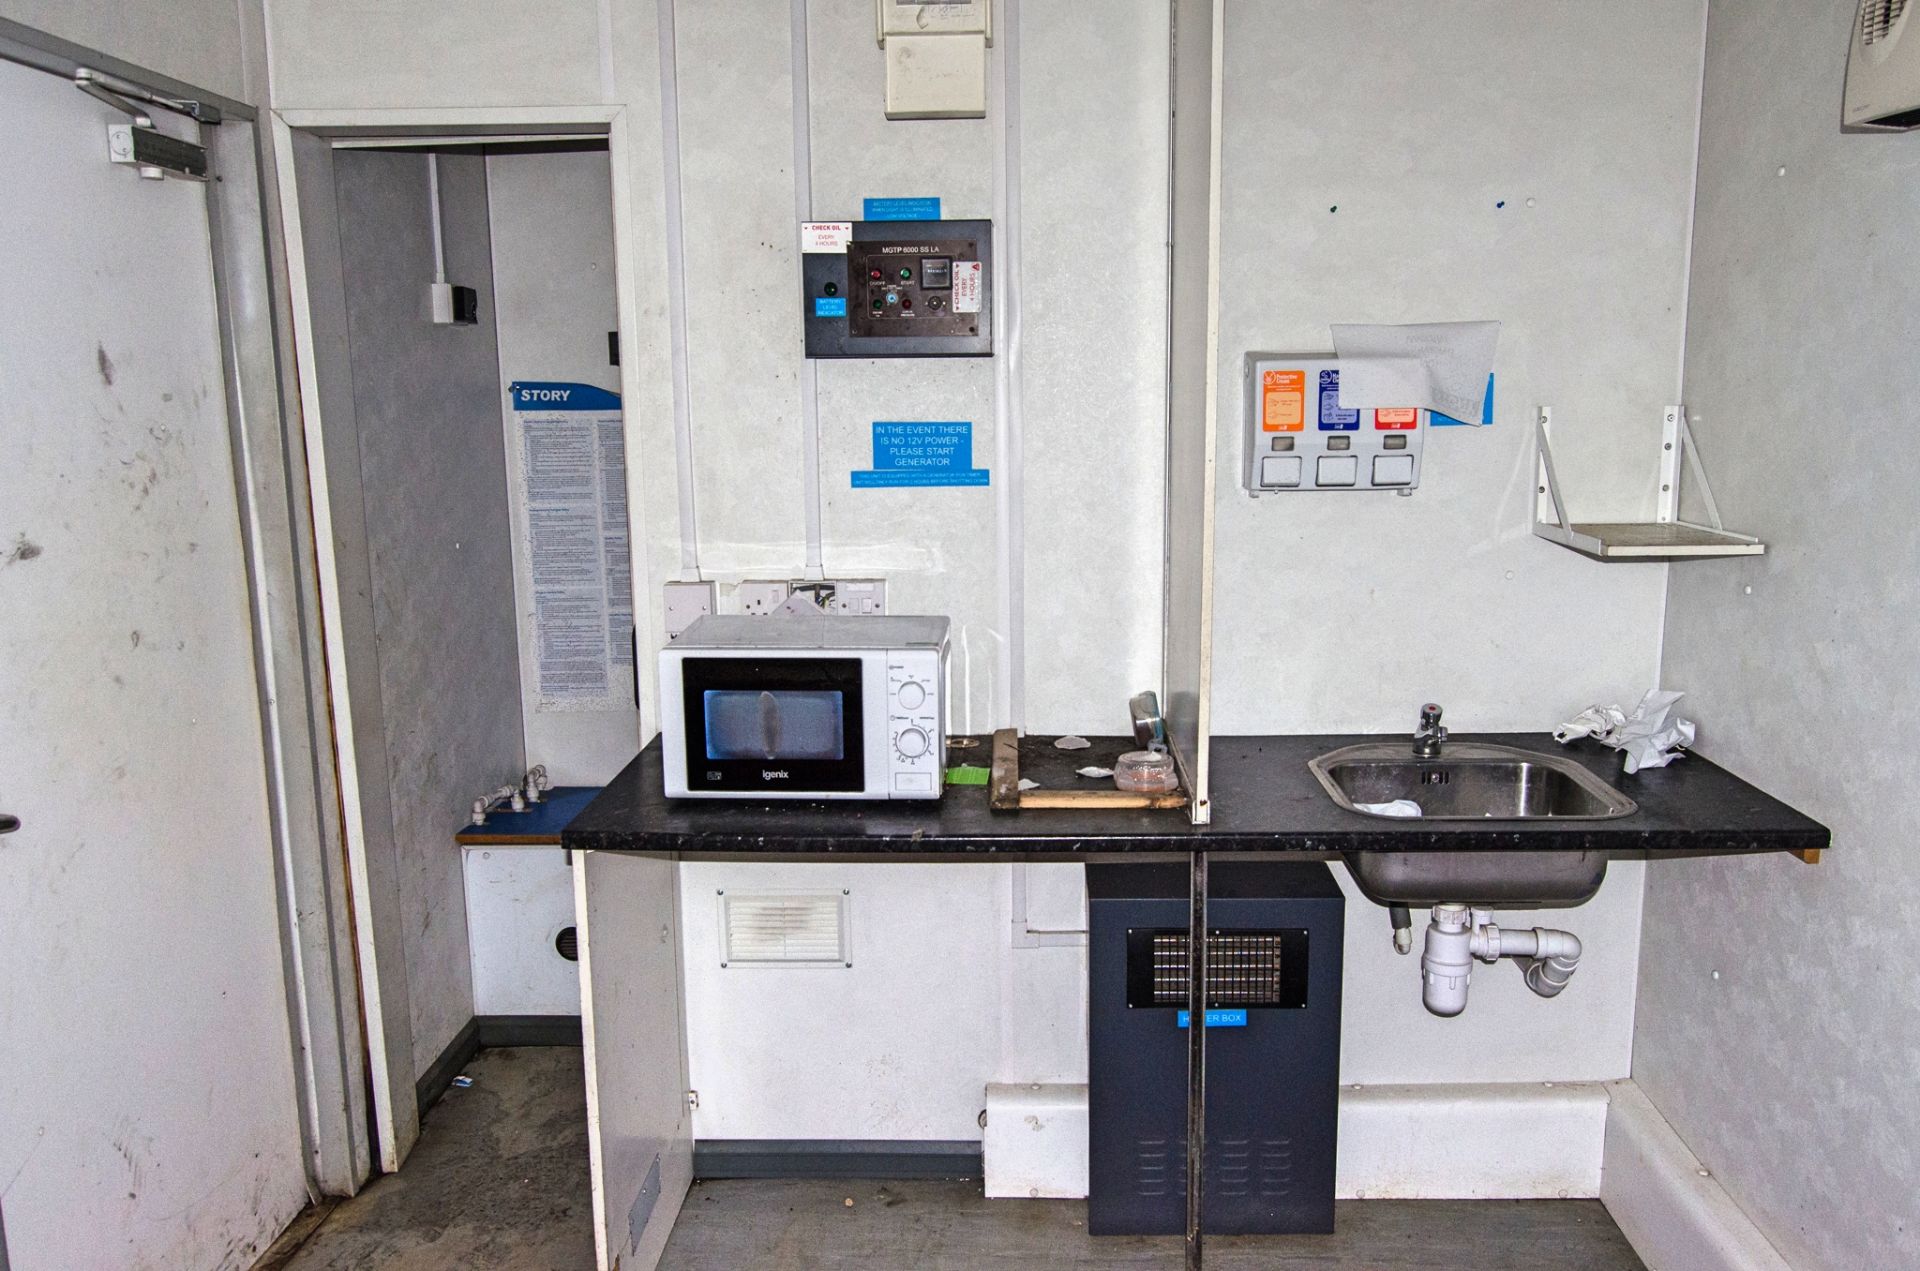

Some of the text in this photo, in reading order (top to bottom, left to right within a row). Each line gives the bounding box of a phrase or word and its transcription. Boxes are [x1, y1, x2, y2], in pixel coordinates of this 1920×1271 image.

[520, 390, 571, 401] STORY
[876, 425, 968, 434] IN THE EVENT THERE
[880, 437, 889, 445] IS
[891, 437, 905, 445] NO
[908, 437, 923, 445] 12V
[925, 436, 958, 445] POWER
[890, 447, 954, 455] PLEASE START
[894, 457, 950, 466] GENERATOR
[762, 769, 789, 780] igenix
